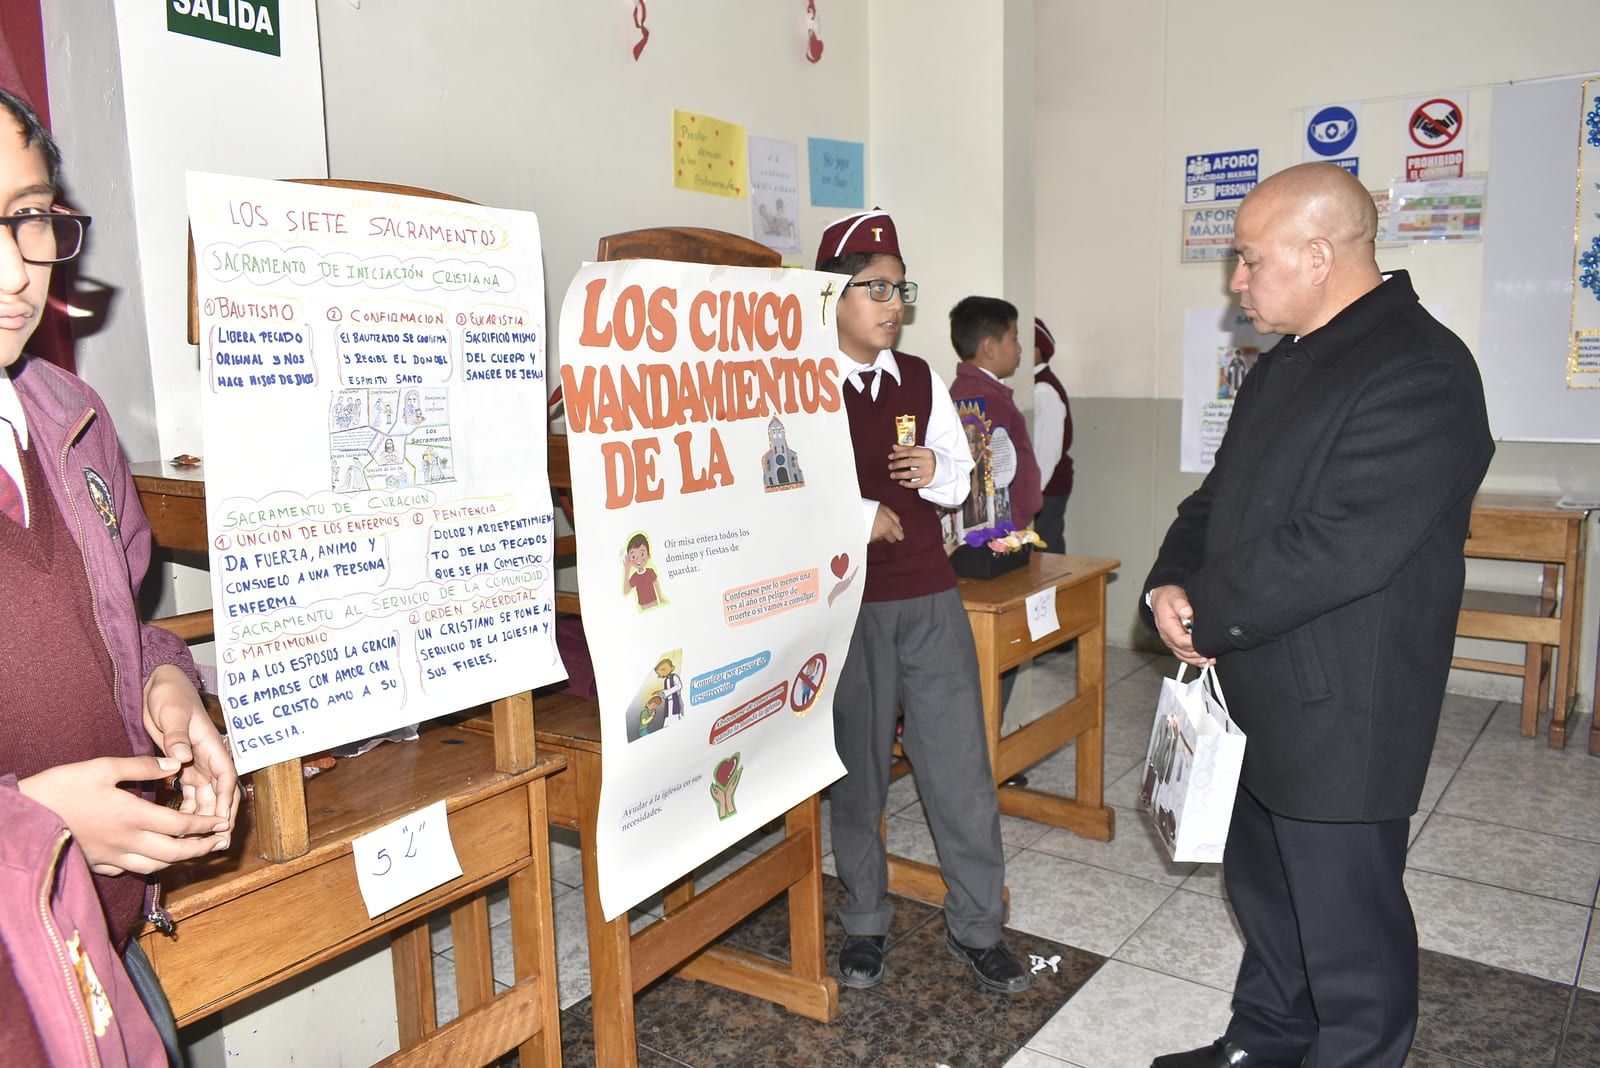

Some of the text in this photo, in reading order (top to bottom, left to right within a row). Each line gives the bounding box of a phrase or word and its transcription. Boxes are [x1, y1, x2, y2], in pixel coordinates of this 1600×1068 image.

[173, 0, 274, 36] SALIDA
[1213, 153, 1258, 170] AFORO
[1408, 152, 1462, 170] PROHIBIDO
[1187, 173, 1226, 183] CAPACIDAD
[1192, 185, 1207, 199] 35
[228, 199, 496, 246] LOS SIETE SACRAMENTOS
[1194, 209, 1236, 222] AFOR
[871, 227, 884, 242] T
[212, 250, 500, 287] SACRAMENTO DE INICIACIÓN CRISTIANA
[215, 297, 294, 321] BAUTISMO
[350, 309, 444, 324] CONFIRMACION
[578, 278, 803, 353] LOS CINCO
[218, 326, 303, 344] LIBERA PECADO
[352, 332, 400, 344] BAUTIZADO
[402, 332, 414, 343] SE
[465, 330, 536, 344] SACRIFICIO MISMO
[216, 351, 305, 365] ORIGINAL NOS
[354, 353, 387, 364] RECIBE
[393, 354, 407, 364] EL
[412, 354, 433, 365] DON
[466, 352, 487, 363] DEL
[490, 352, 525, 364] CUERPO
[217, 373, 314, 387] HACE HIJOS DE DIOS
[348, 373, 423, 385] ESPIRITU SANTO
[466, 369, 517, 381] SANGRE DE
[560, 357, 842, 434] MANDAMIENTOS
[600, 427, 736, 510] DE LA
[223, 493, 429, 528] SACRAMENTO DE CURACION
[433, 503, 497, 521] PENITENCIA
[298, 525, 318, 540] DE
[324, 522, 342, 534] LOS
[347, 516, 400, 533] ENFERMOS
[433, 527, 466, 540] DOLOR
[678, 536, 696, 547] misa
[696, 532, 719, 545] entera
[719, 529, 739, 541] todos
[739, 528, 751, 538] los
[224, 555, 249, 571] DA
[254, 548, 314, 569] FUERZA,
[318, 541, 357, 559] ANIMO
[430, 534, 548, 560] TO DE LOS PECADOS
[665, 542, 740, 564] domingo y fiestas de
[225, 558, 386, 594] CONSUELO A UNA PERSONA
[434, 554, 543, 580] QUE SE HA COMETIDO
[724, 586, 761, 603] Confesarse
[760, 582, 773, 596] por
[779, 574, 799, 588] menos
[726, 586, 798, 611] ves al año en peligro de
[228, 595, 297, 618] ENFERMA
[228, 609, 333, 641] SACRAMENTO
[344, 604, 363, 618] AL
[371, 591, 430, 611] SERVICIO
[440, 585, 455, 600] DE
[464, 580, 480, 593] LA
[424, 590, 536, 622] ORDEN SACERDOTAL
[728, 609, 751, 622] muerte
[763, 601, 784, 613] vamos
[417, 602, 552, 641] UN CRISTIANO SE PONE AL
[242, 632, 328, 661] MATRIMONIO
[420, 641, 465, 662] SERVICIO
[469, 637, 483, 650] DE
[487, 632, 498, 645] LA
[227, 635, 397, 687] DA A LOS ESPOSOS LA GRACIA
[227, 659, 390, 710] DE AMARSE CON AMOR CON
[427, 666, 447, 681] SUS
[231, 678, 397, 730] QUE CRISTO AMO A SU
[622, 801, 648, 819] Ayudar
[653, 793, 661, 803] la
[372, 848, 392, 876] 5
